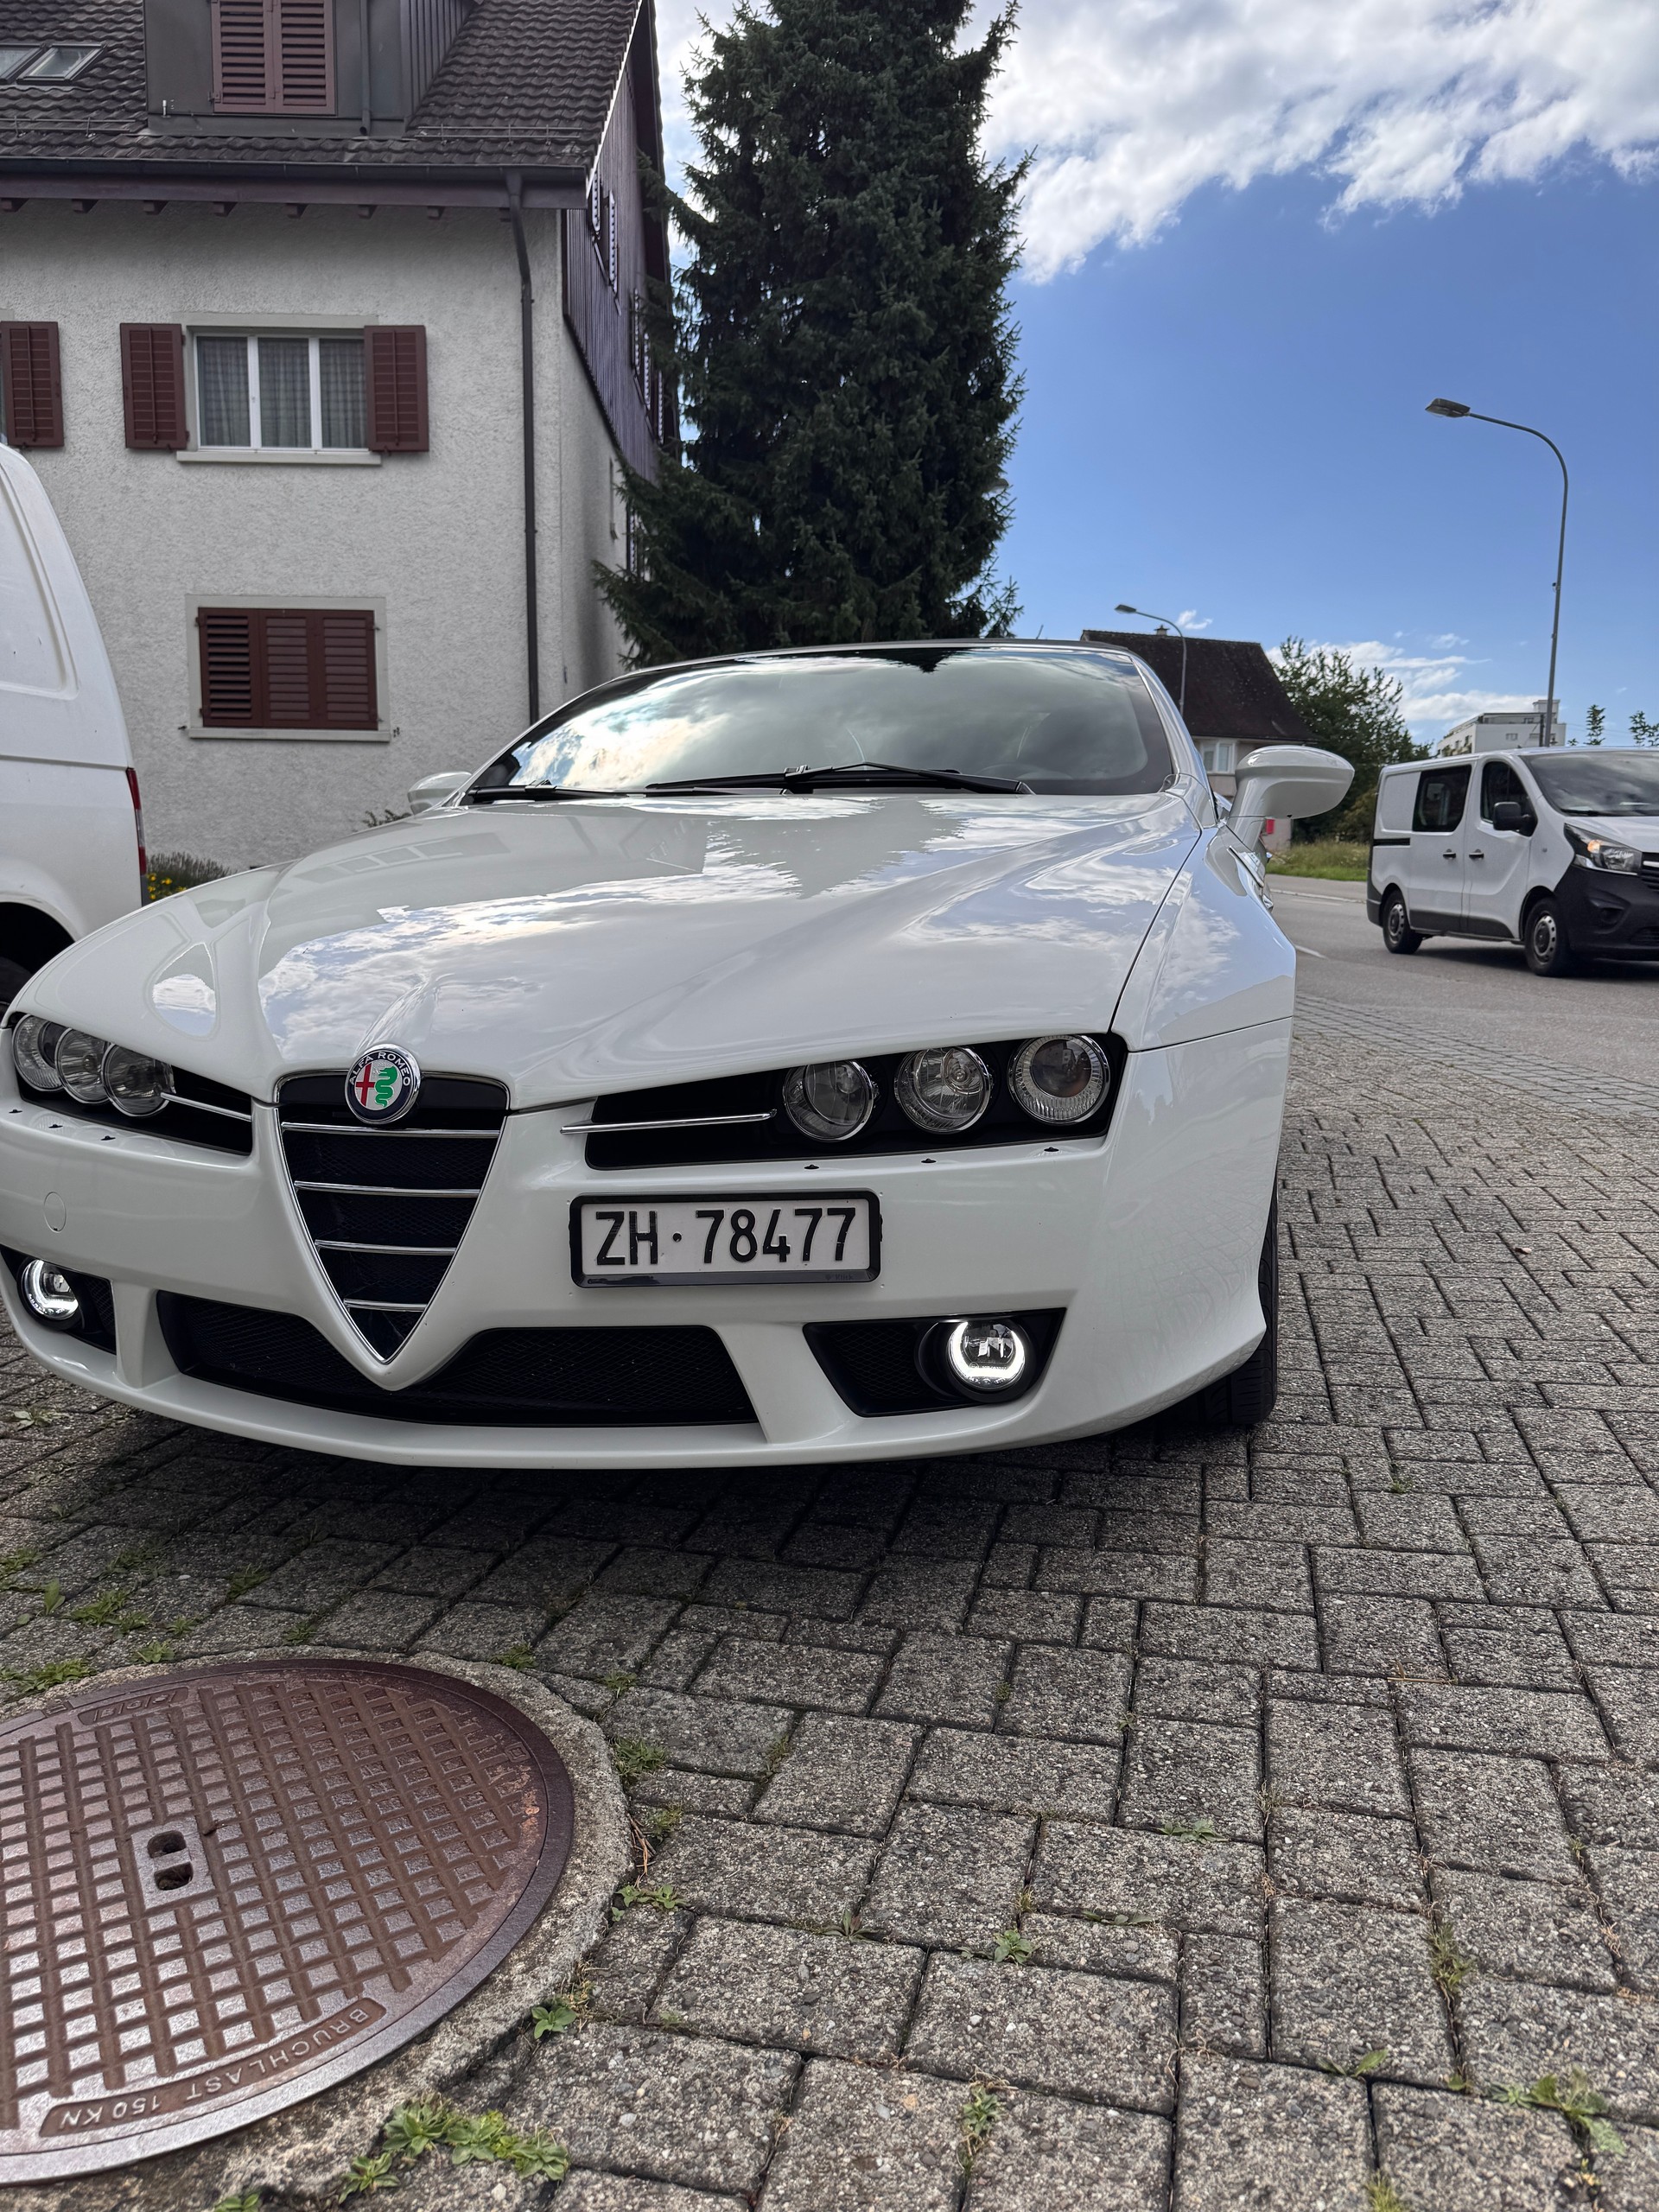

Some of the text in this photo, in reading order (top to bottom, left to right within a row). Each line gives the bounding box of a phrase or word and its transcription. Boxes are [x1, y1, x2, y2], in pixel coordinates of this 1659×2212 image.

[349, 1052, 411, 1086] ALFA ROMEO
[695, 1207, 856, 1264] 78477
[60, 2007, 370, 2128] BRUCHLAST 150 KN
